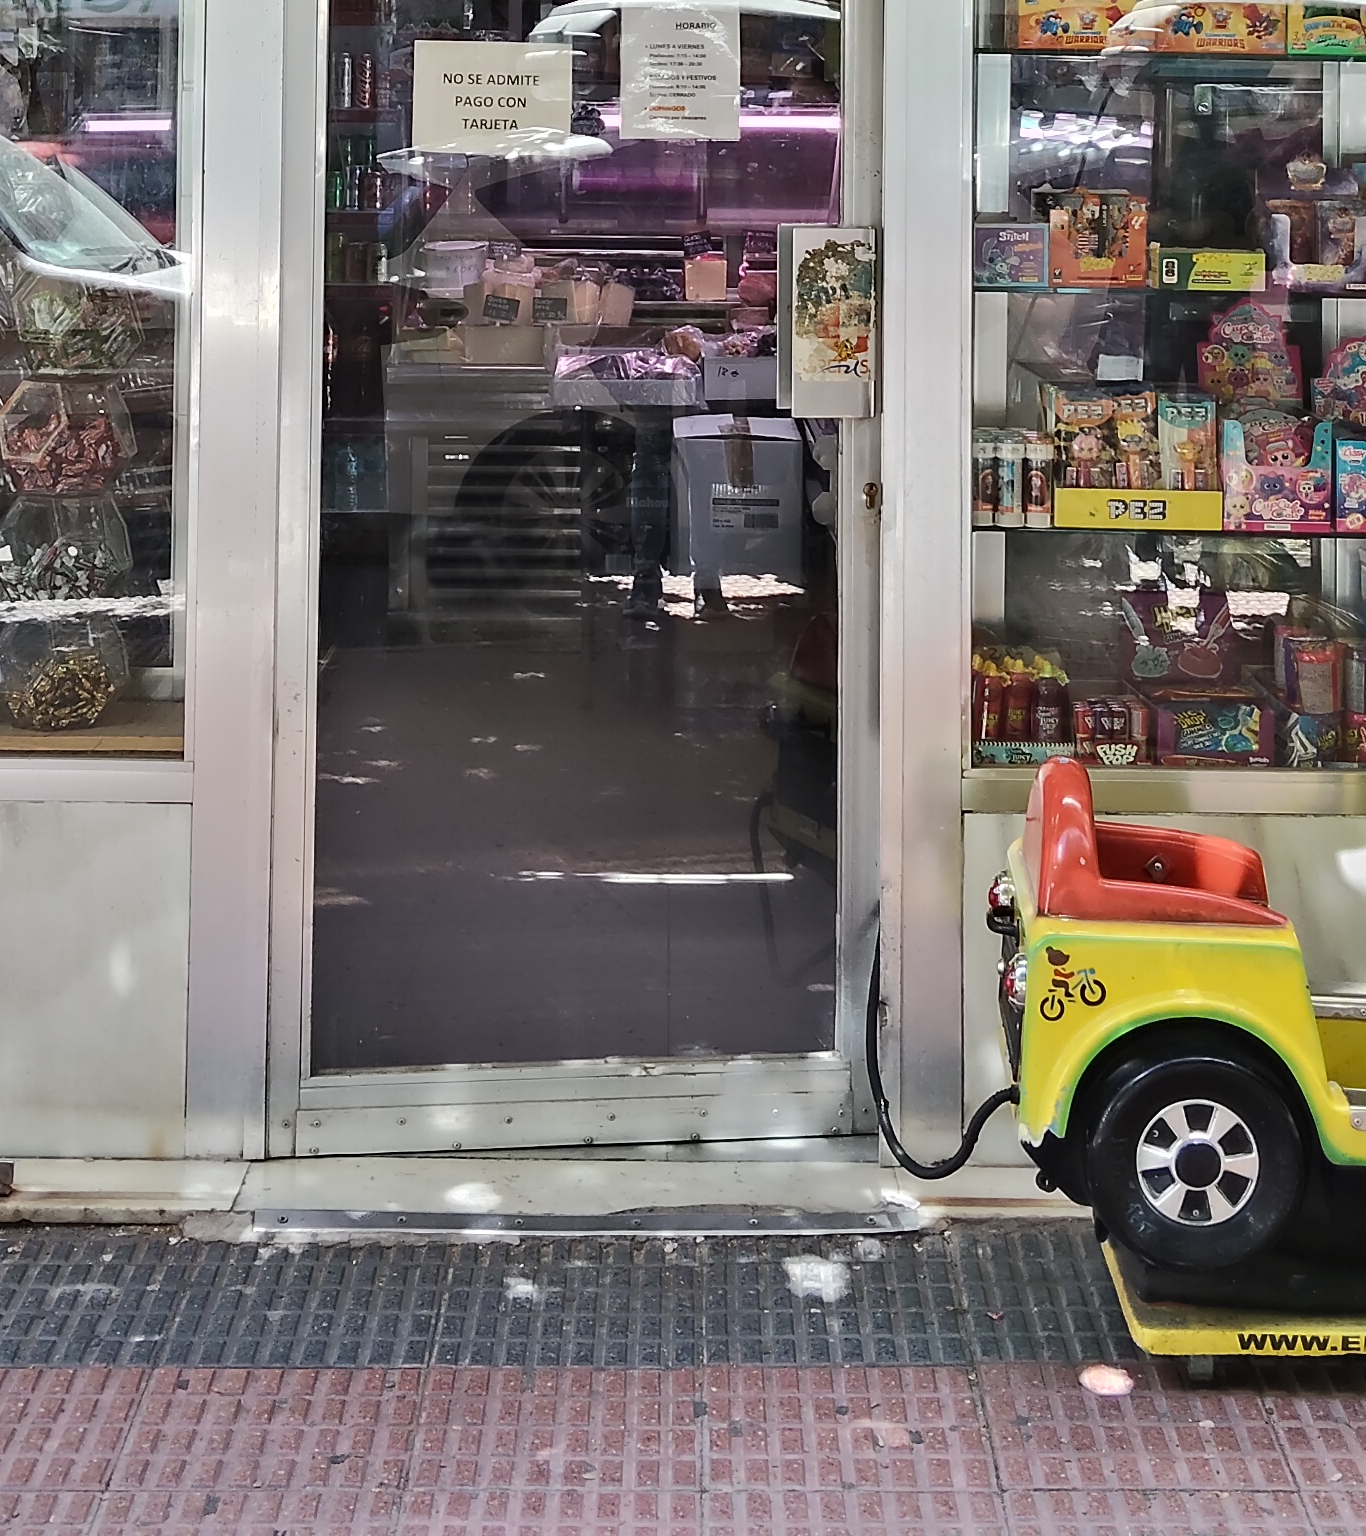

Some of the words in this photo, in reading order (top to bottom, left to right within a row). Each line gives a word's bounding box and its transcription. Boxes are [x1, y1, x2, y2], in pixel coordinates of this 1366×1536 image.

[1196, 37, 1245, 50] WARRIORS
[443, 72, 466, 86] NO
[469, 73, 484, 86] SE
[487, 73, 540, 86] ADMITE
[454, 95, 493, 109] PAGO
[497, 96, 527, 110] CON
[462, 117, 519, 131] TARJETA
[1063, 404, 1104, 419] PEZ
[1165, 406, 1206, 421] PEZ
[1107, 499, 1167, 520] PEZ
[1096, 744, 1138, 757] PUSH
[1102, 755, 1135, 765] POP
